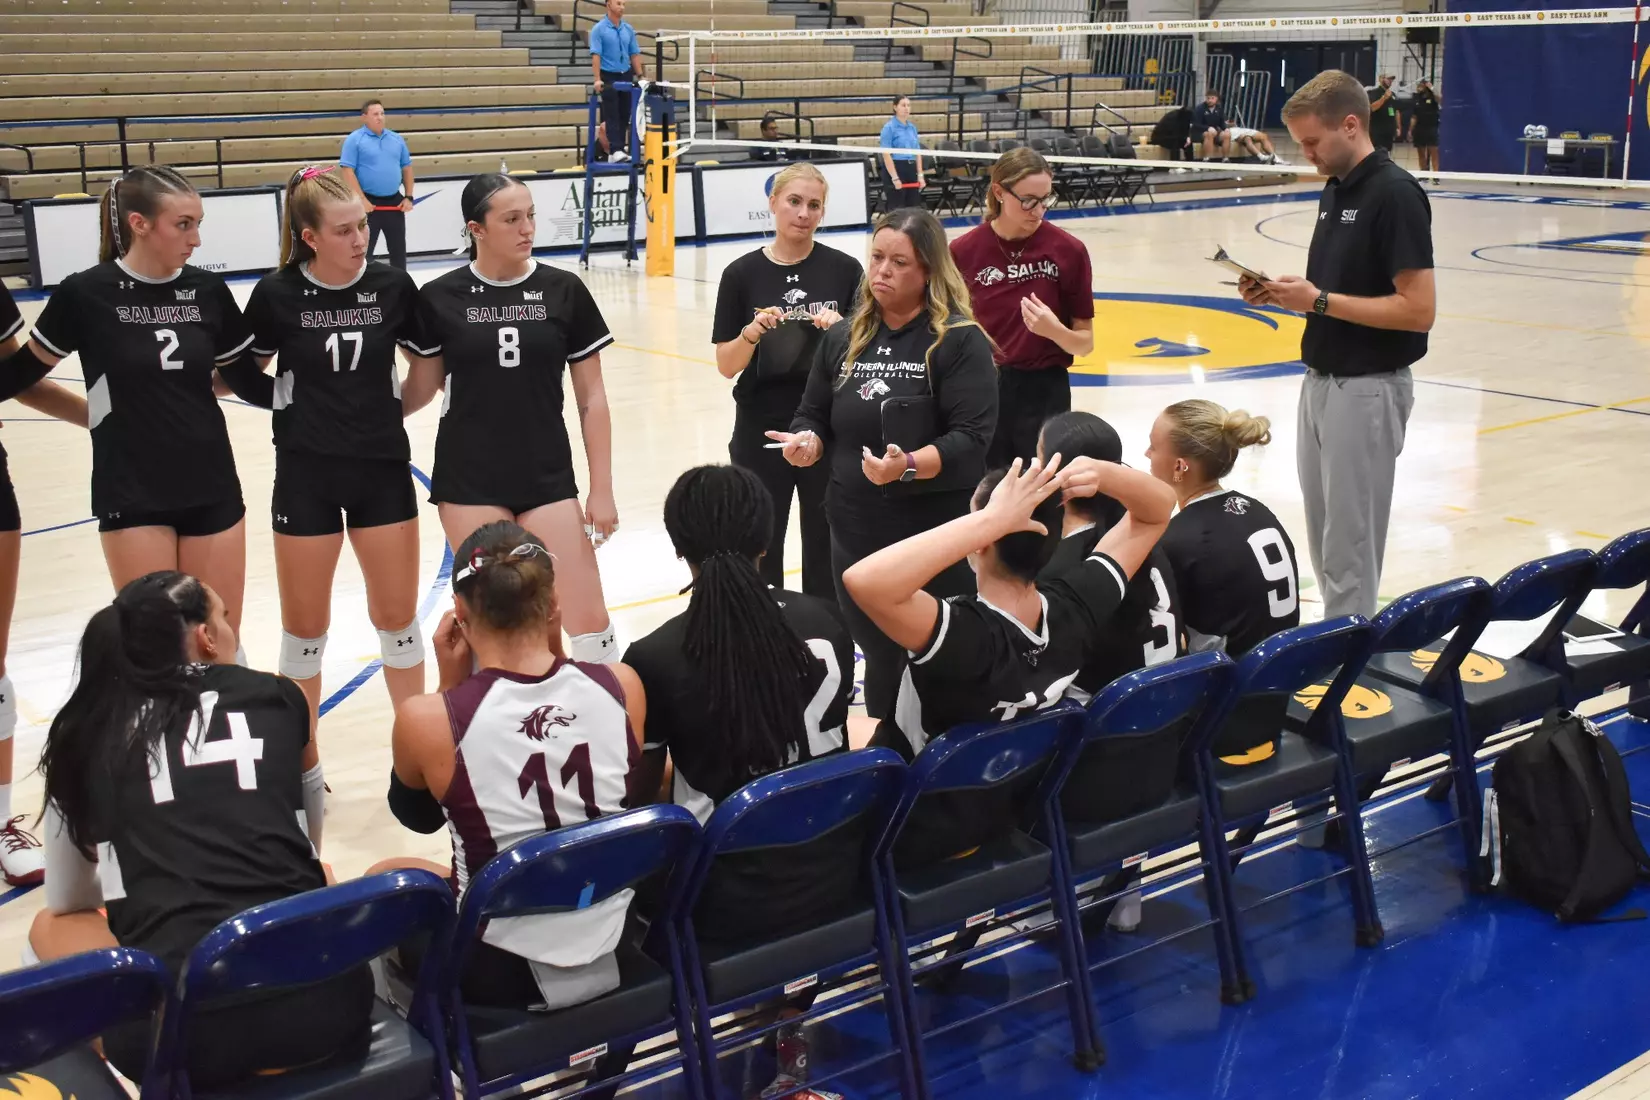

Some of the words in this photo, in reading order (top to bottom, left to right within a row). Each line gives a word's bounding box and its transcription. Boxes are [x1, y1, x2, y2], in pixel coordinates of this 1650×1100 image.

[1006, 260, 1059, 279] SALUKI
[174, 289, 196, 300] VALLEY
[356, 292, 377, 303] VALLEY
[522, 290, 543, 301] VALLEY
[116, 305, 202, 324] SALUKIS
[300, 307, 382, 328] SALUKIS
[466, 304, 547, 323] SALUKIS
[154, 328, 184, 371] 2
[325, 331, 363, 372] 17
[498, 326, 521, 368] 8
[840, 361, 884, 372] SUTHERN
[886, 361, 925, 373] ILLINOIS
[852, 371, 909, 379] OLLEYBALL
[1246, 527, 1297, 618] 9
[135, 690, 264, 804] 14
[517, 741, 601, 832] 11
